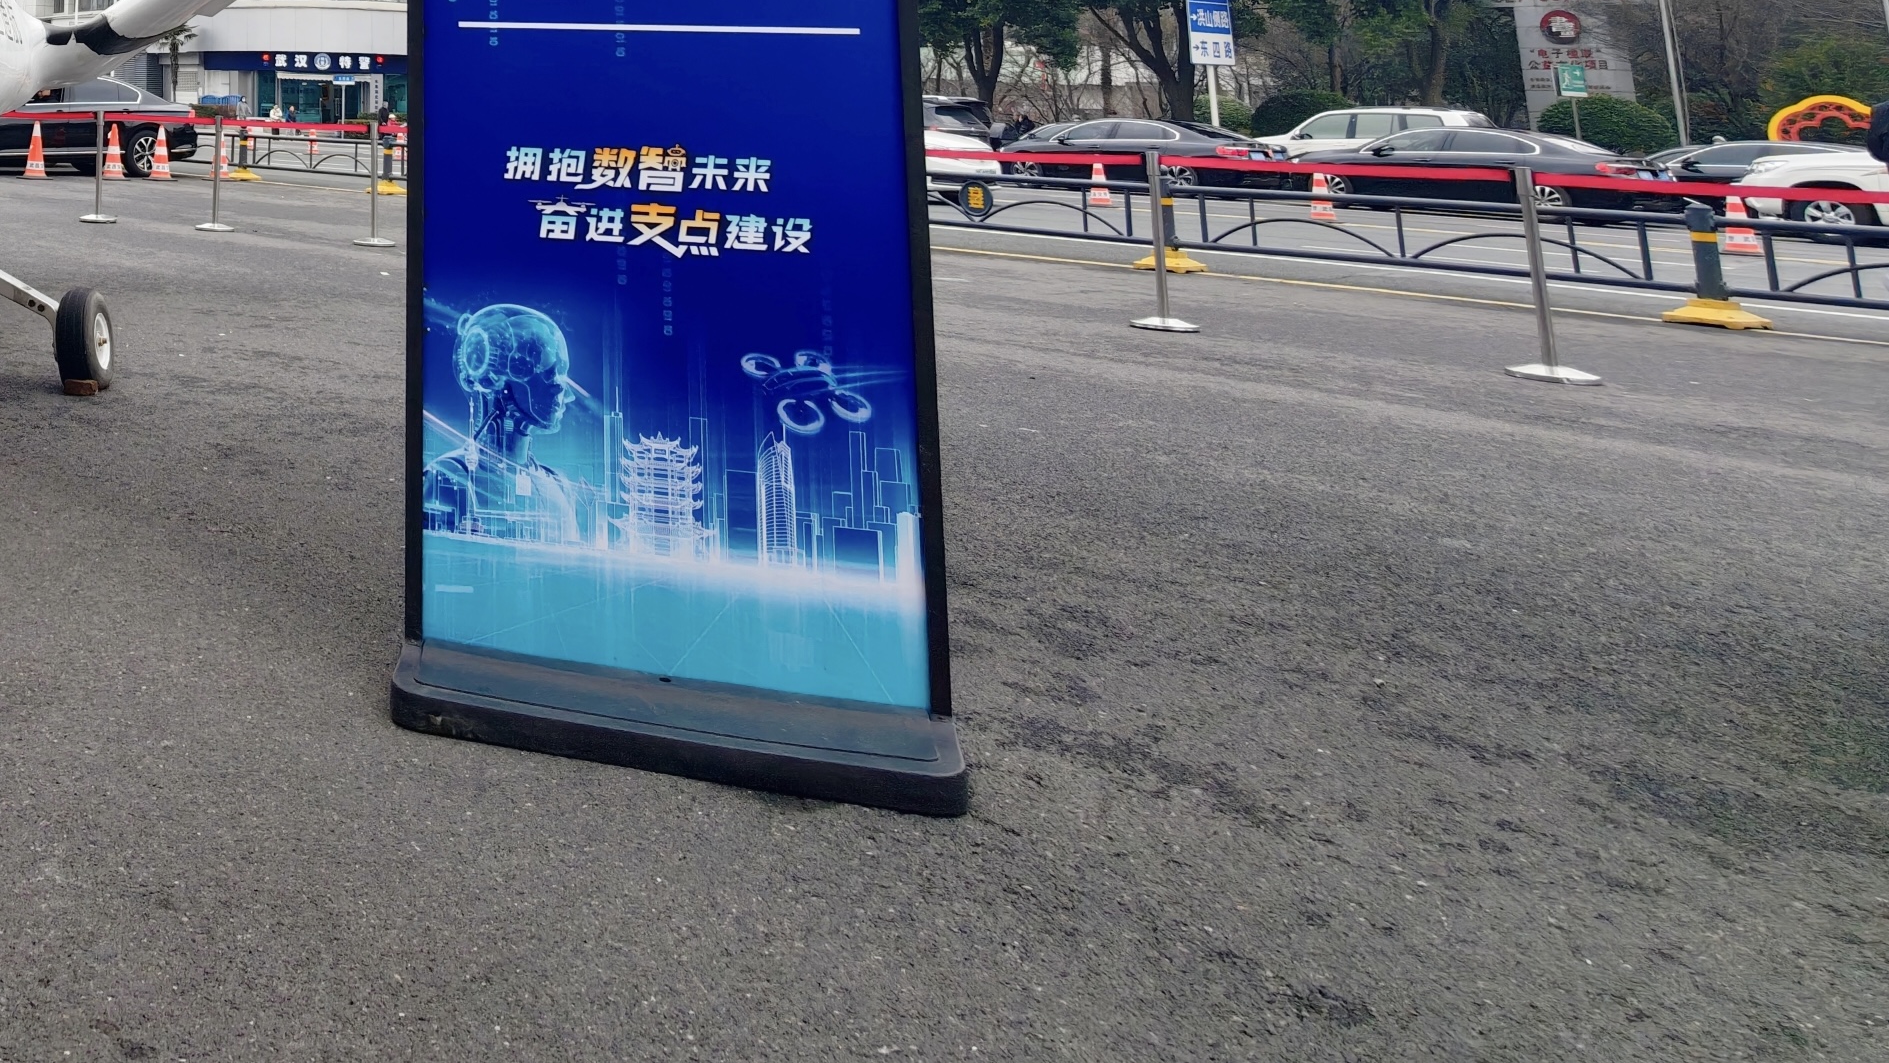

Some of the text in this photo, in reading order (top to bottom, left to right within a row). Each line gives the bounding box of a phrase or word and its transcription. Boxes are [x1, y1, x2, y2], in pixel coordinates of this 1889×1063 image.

[1197, 8, 1230, 29] 洪山侧路
[275, 53, 371, 70] 武汉 特警
[504, 145, 771, 192] 拥抱数智未来
[532, 196, 813, 258] 奋进支点建设
